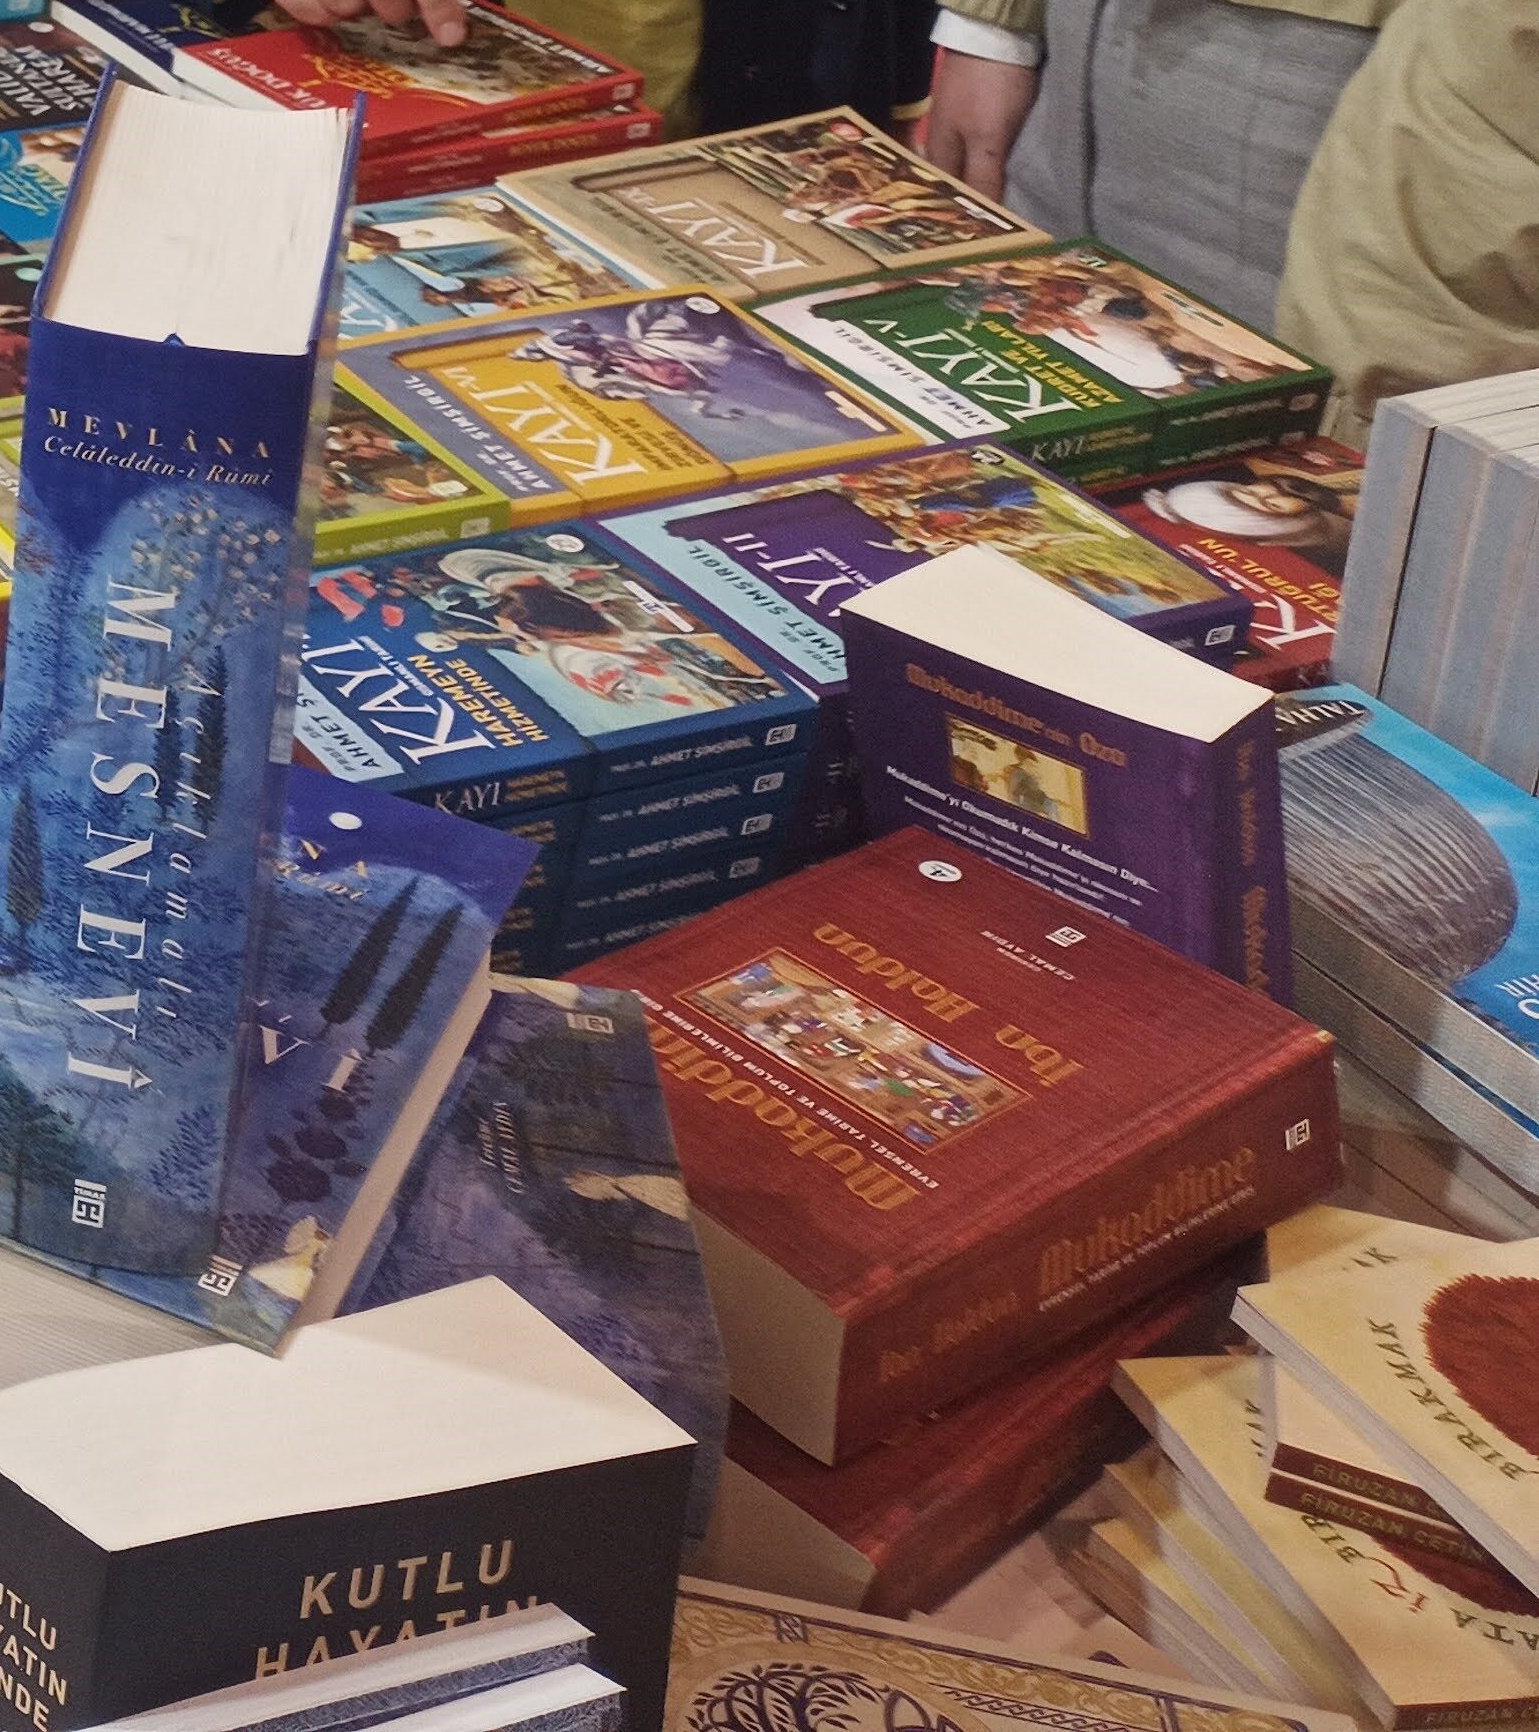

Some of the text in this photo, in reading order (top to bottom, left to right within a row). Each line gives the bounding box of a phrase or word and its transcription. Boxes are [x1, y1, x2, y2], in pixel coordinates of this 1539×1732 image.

[482, 440, 551, 491] AHMET
[407, 654, 524, 748] HAREMEYN
[311, 714, 382, 769] AHMET
[435, 781, 501, 815] KAYI
[870, 1139, 940, 1190] EVRENSEL
[1039, 1148, 1256, 1297] Mukaddime
[1366, 1317, 1525, 1482] BIRAKMAK
[299, 1539, 514, 1620] KUTLU
